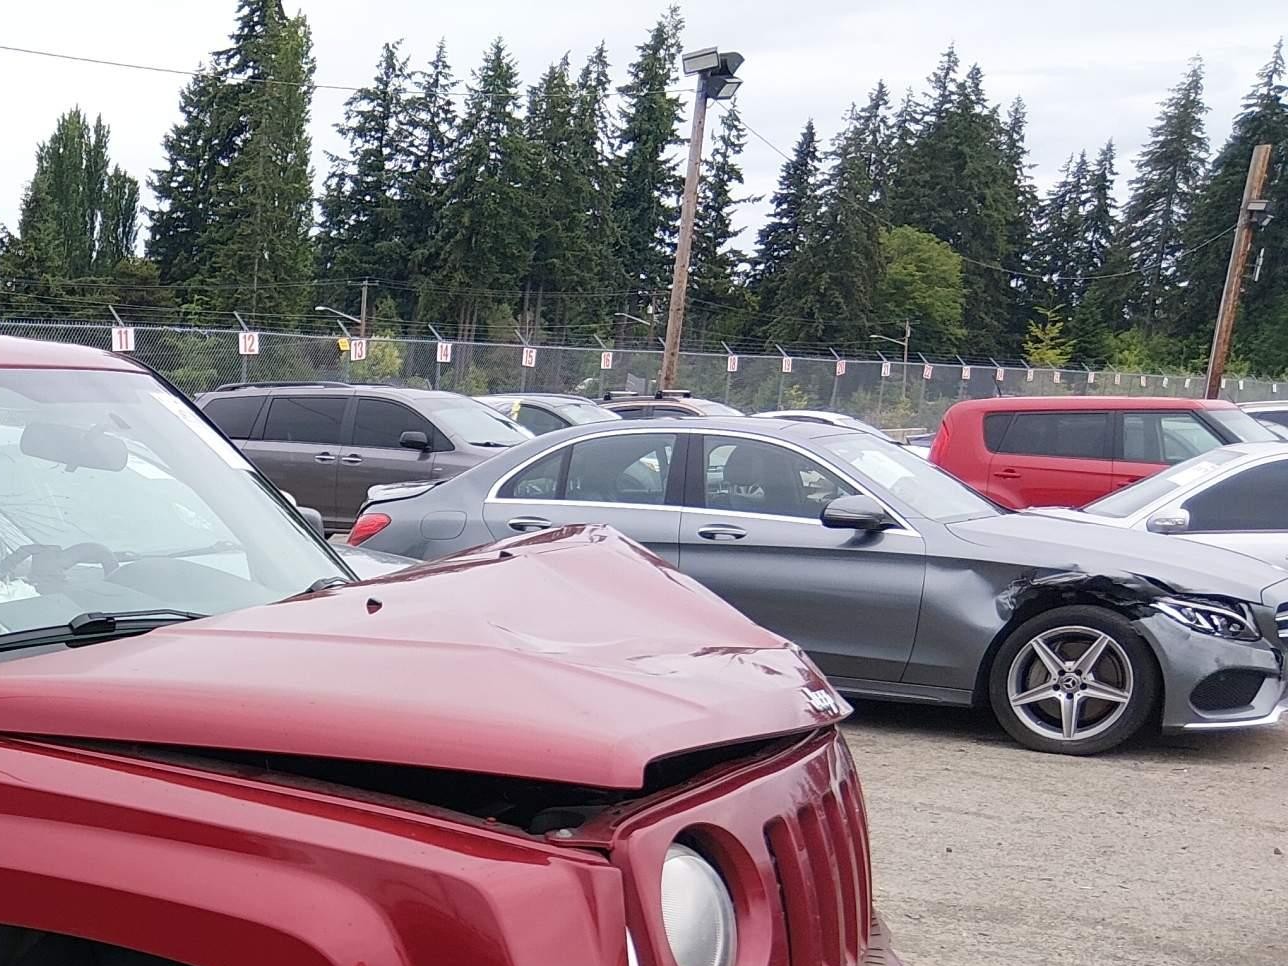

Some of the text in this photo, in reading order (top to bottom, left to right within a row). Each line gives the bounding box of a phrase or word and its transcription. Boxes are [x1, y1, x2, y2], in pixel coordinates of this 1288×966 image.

[117, 329, 129, 350] 11
[243, 334, 255, 352] 12
[354, 341, 363, 359] 13
[440, 344, 449, 360] 14
[525, 349, 533, 365] 15
[603, 354, 610, 369] 16
